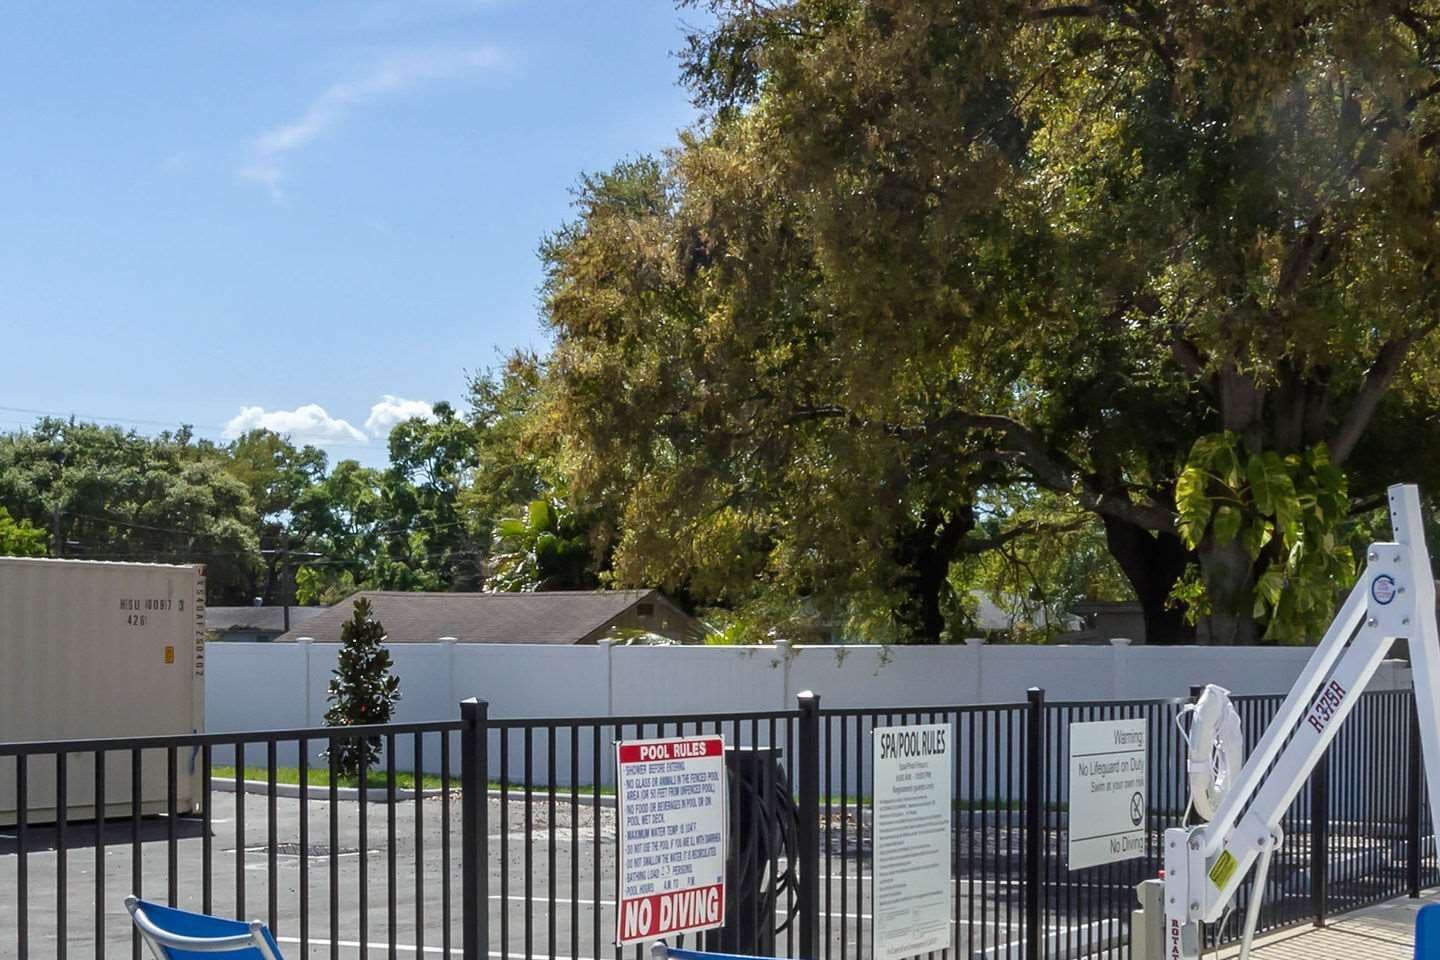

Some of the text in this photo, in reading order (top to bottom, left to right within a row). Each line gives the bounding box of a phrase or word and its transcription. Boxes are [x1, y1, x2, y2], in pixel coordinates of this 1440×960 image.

[1308, 680, 1347, 734] R-375R
[922, 729, 946, 756] RULES
[1113, 728, 1143, 747] Warning
[640, 742, 706, 760] POOL RULES
[707, 772, 720, 781] POOL
[1078, 757, 1144, 779] No Lifeguard on Duty
[686, 799, 697, 808] POOL
[627, 816, 640, 825] POOL
[1110, 836, 1144, 854] No Diving
[624, 887, 720, 938] NO DIVING
